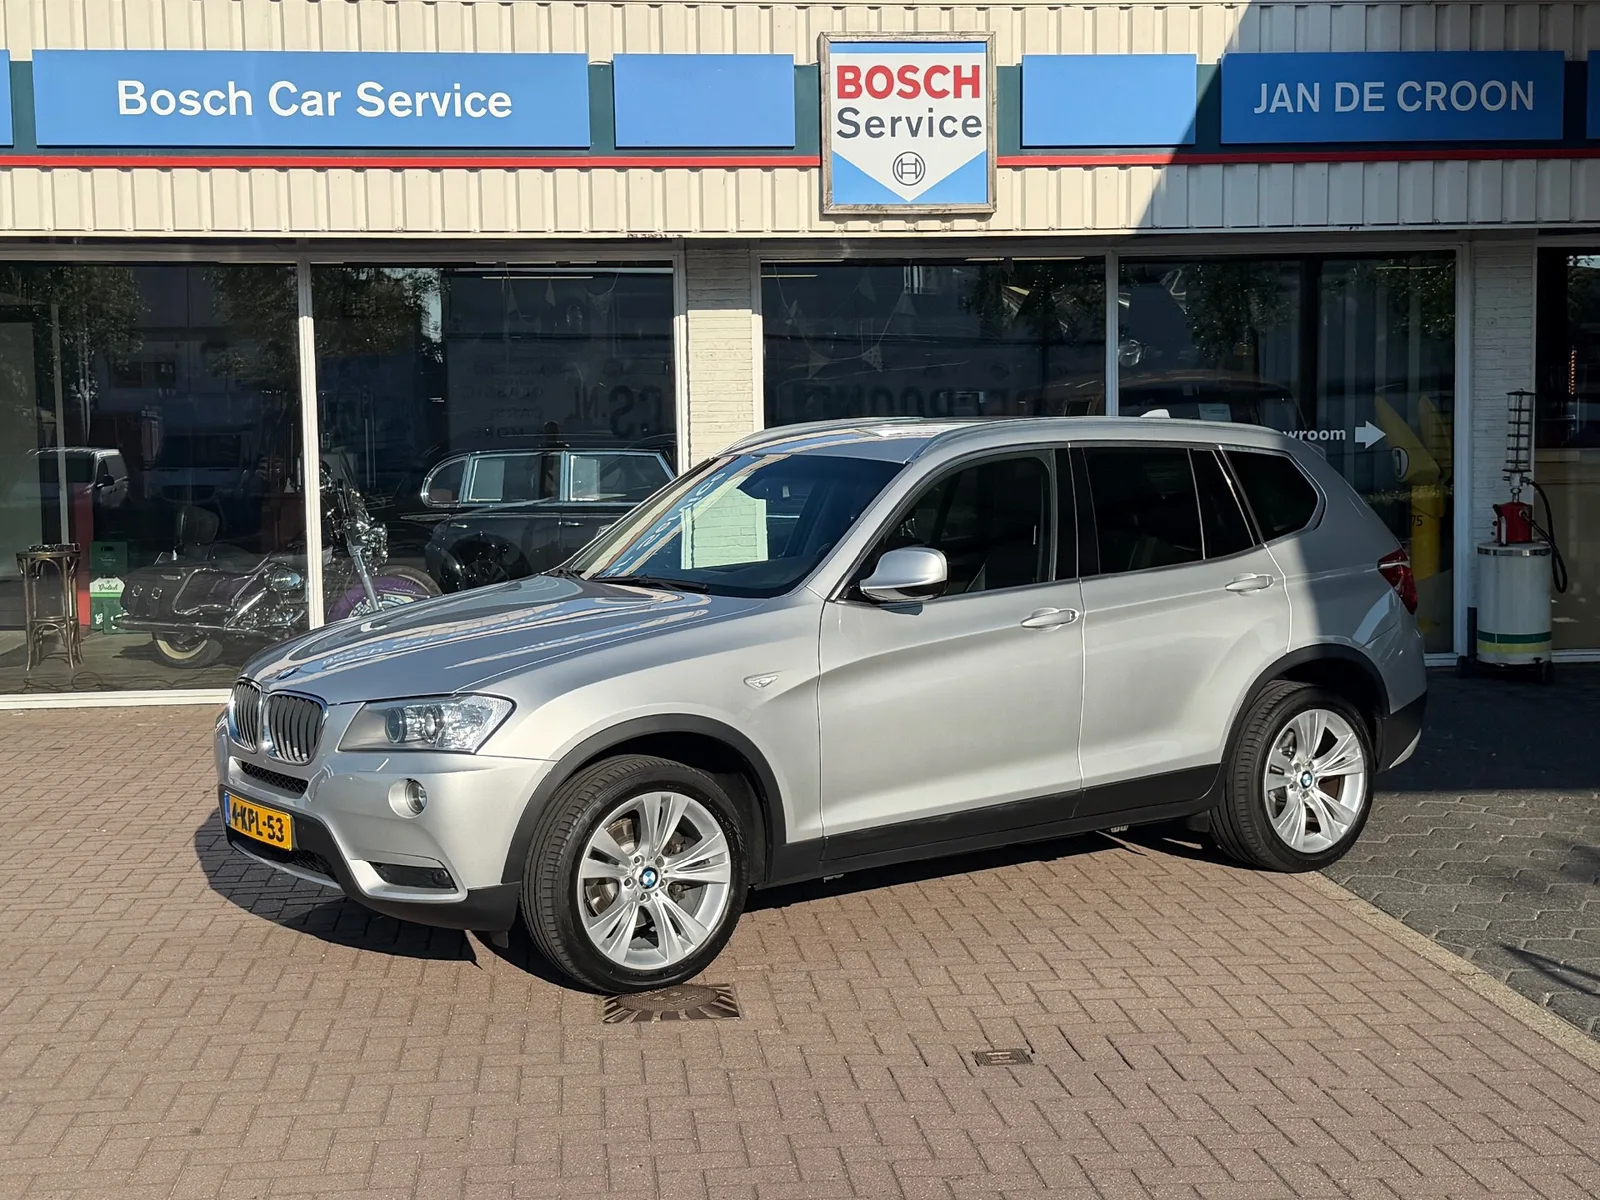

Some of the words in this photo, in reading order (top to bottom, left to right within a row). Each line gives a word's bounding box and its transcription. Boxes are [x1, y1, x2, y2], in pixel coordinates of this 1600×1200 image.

[117, 80, 253, 117] Bosch
[268, 80, 342, 117] Car
[356, 82, 513, 118] Service
[836, 64, 981, 100] BOSCH
[1253, 81, 1321, 115] JAN
[1333, 82, 1386, 114] DE
[1396, 79, 1535, 113] CROON
[836, 106, 983, 139] Service
[231, 801, 285, 843] 4-KPL-53
